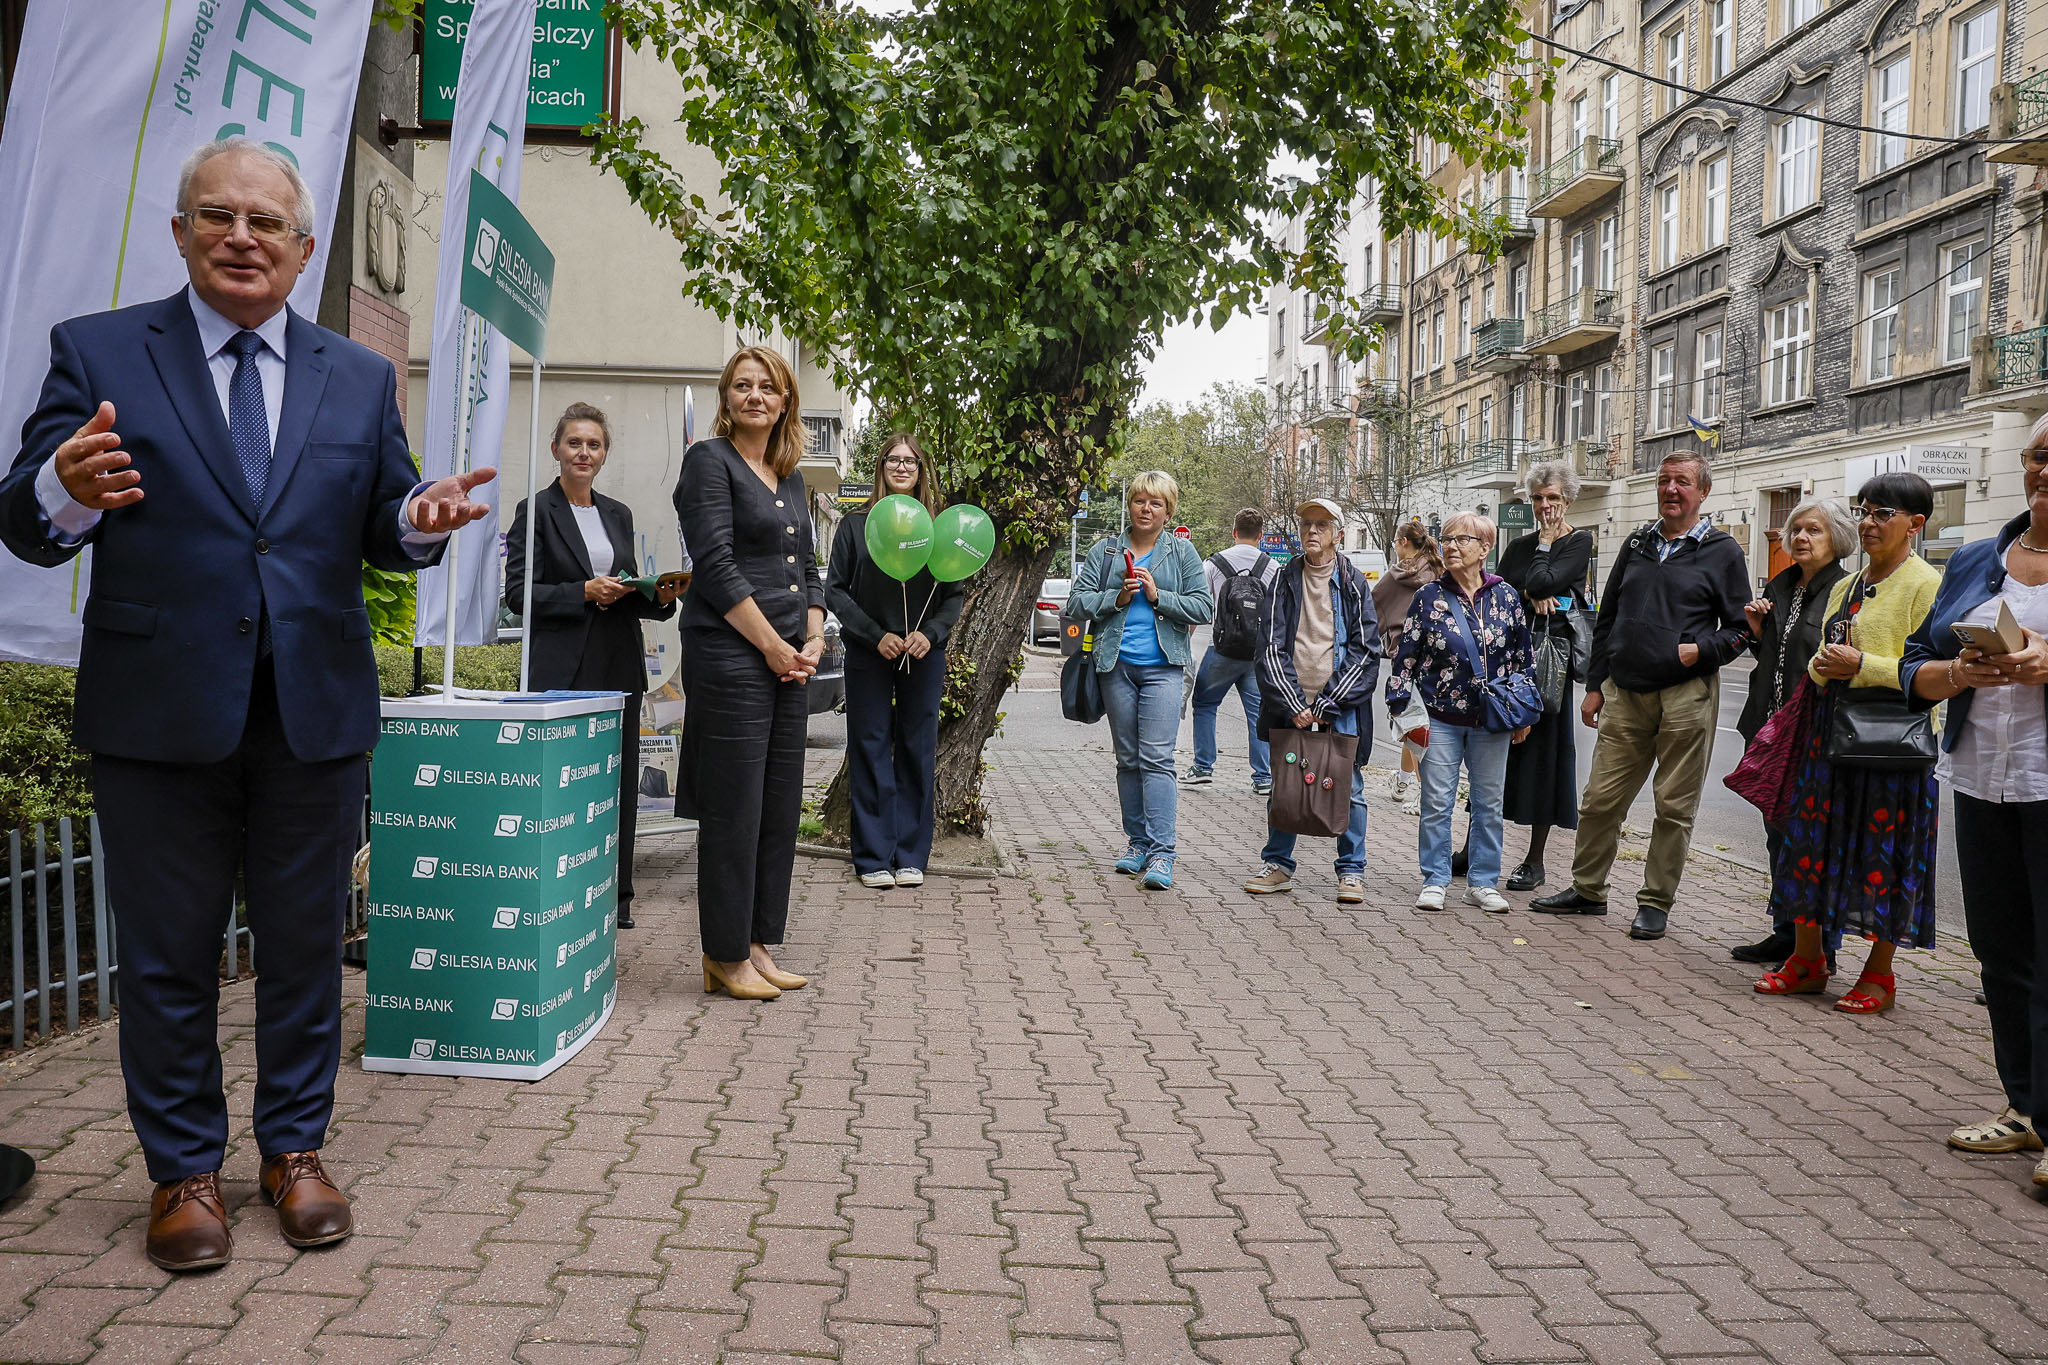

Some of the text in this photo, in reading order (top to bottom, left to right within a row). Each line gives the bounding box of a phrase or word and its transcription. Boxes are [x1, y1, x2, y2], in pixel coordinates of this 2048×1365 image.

[439, 86, 457, 100] w
[499, 238, 531, 294] SILESIA
[1922, 450, 1968, 460] OBRĄCZKI
[1917, 464, 1971, 476] PIERŚCIONKI
[1174, 530, 1190, 539] STOP
[380, 721, 460, 737] LESIA BANK
[527, 724, 577, 741] SILESIA BANK
[443, 769, 541, 787] SILESIA BANK
[570, 762, 601, 782] SILESIA BANK
[370, 810, 457, 830] SILESIA BANK
[524, 812, 576, 834] SILESIA BANK
[567, 845, 599, 870] SILESIA BANK
[441, 862, 539, 880] SILESIA BANK
[367, 902, 455, 922] SILESIA BANK
[522, 899, 574, 926] SILESIA BANK
[567, 928, 597, 957] SILESIA BANK
[439, 953, 538, 972] SILESIA BANK
[365, 991, 454, 1013] SILESIA BANK
[521, 986, 574, 1018] SILESIA BANK
[566, 1010, 596, 1043] SILESIA BANK
[439, 1044, 536, 1062] SILESIA BANK
